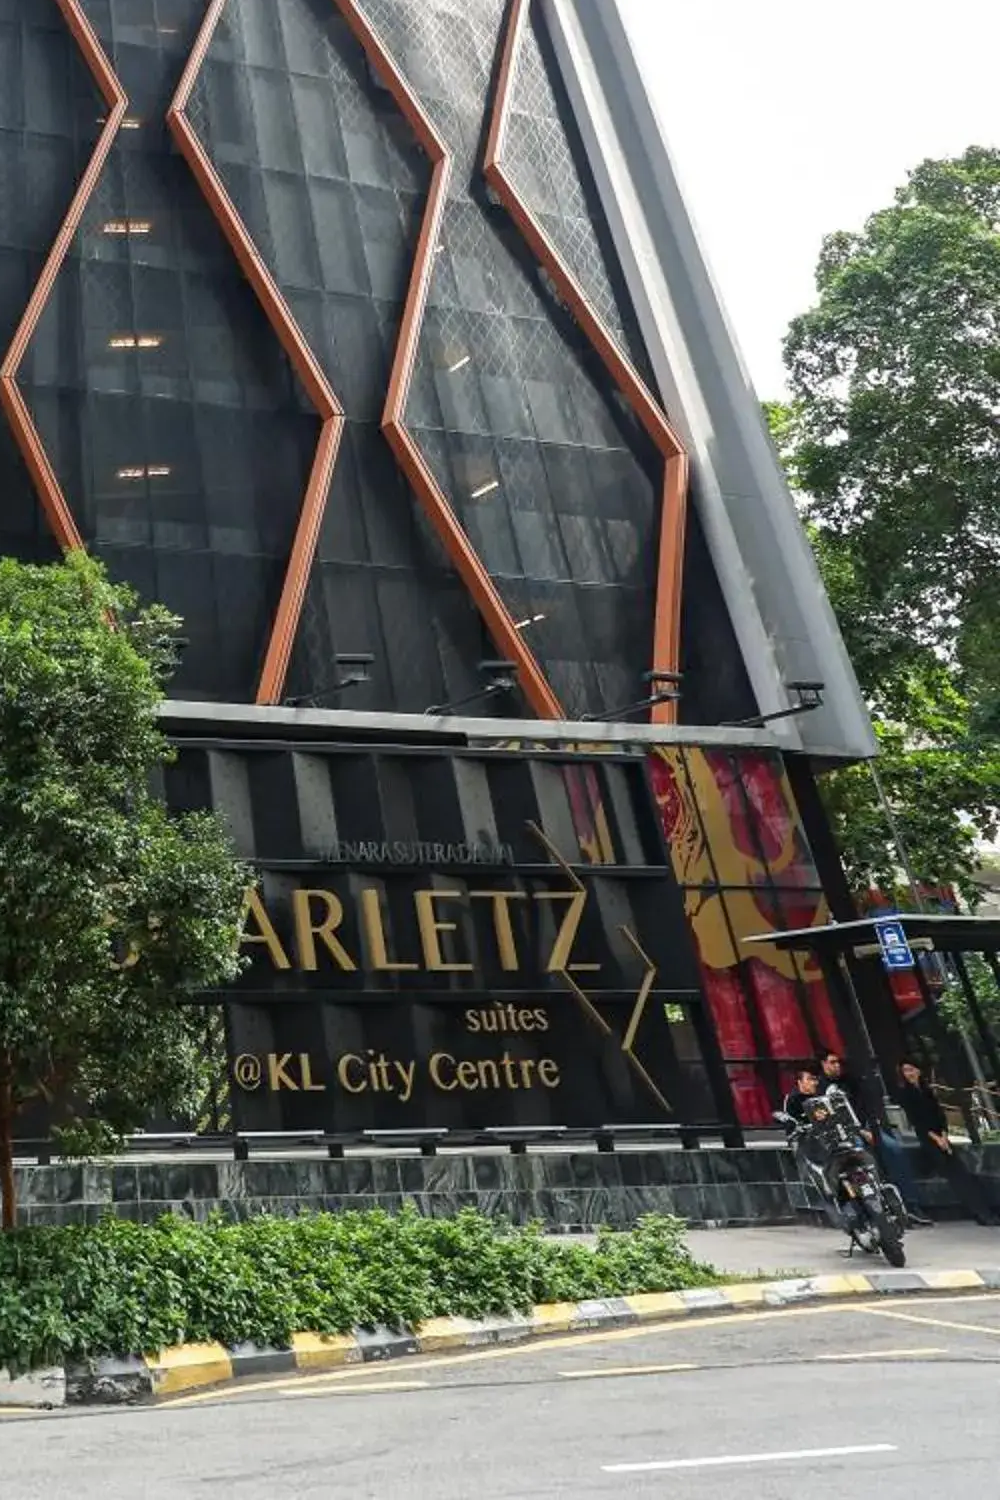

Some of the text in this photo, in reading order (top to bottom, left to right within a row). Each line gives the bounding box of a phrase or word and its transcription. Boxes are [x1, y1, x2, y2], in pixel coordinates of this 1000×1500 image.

[104, 880, 602, 973] ARLETZ
[464, 1000, 549, 1034] suites
[338, 1049, 415, 1103] City
[429, 1051, 561, 1091] Centre
